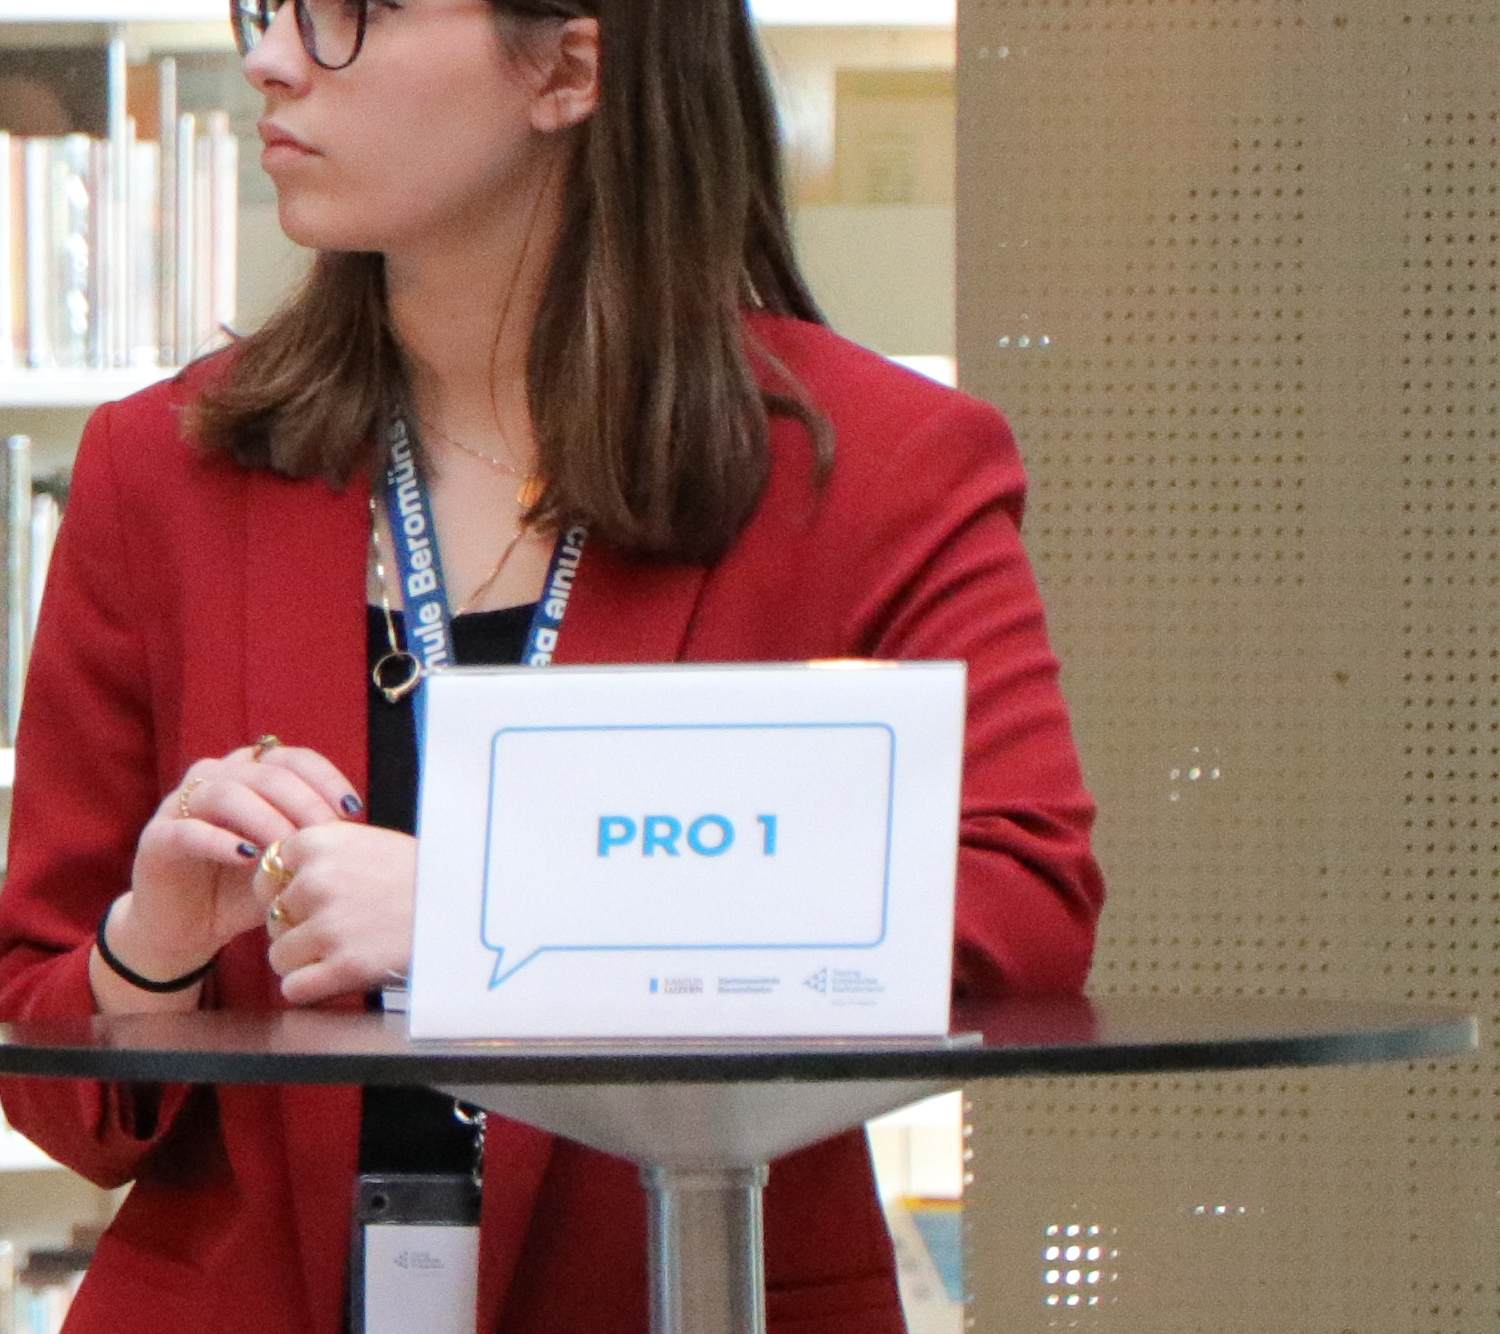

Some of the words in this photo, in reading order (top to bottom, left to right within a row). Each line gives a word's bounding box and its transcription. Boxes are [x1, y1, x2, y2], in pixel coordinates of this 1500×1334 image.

[388, 419, 438, 597] Beromüns
[531, 627, 559, 666] Be
[596, 813, 737, 858] PRO
[757, 814, 779, 857] 1
